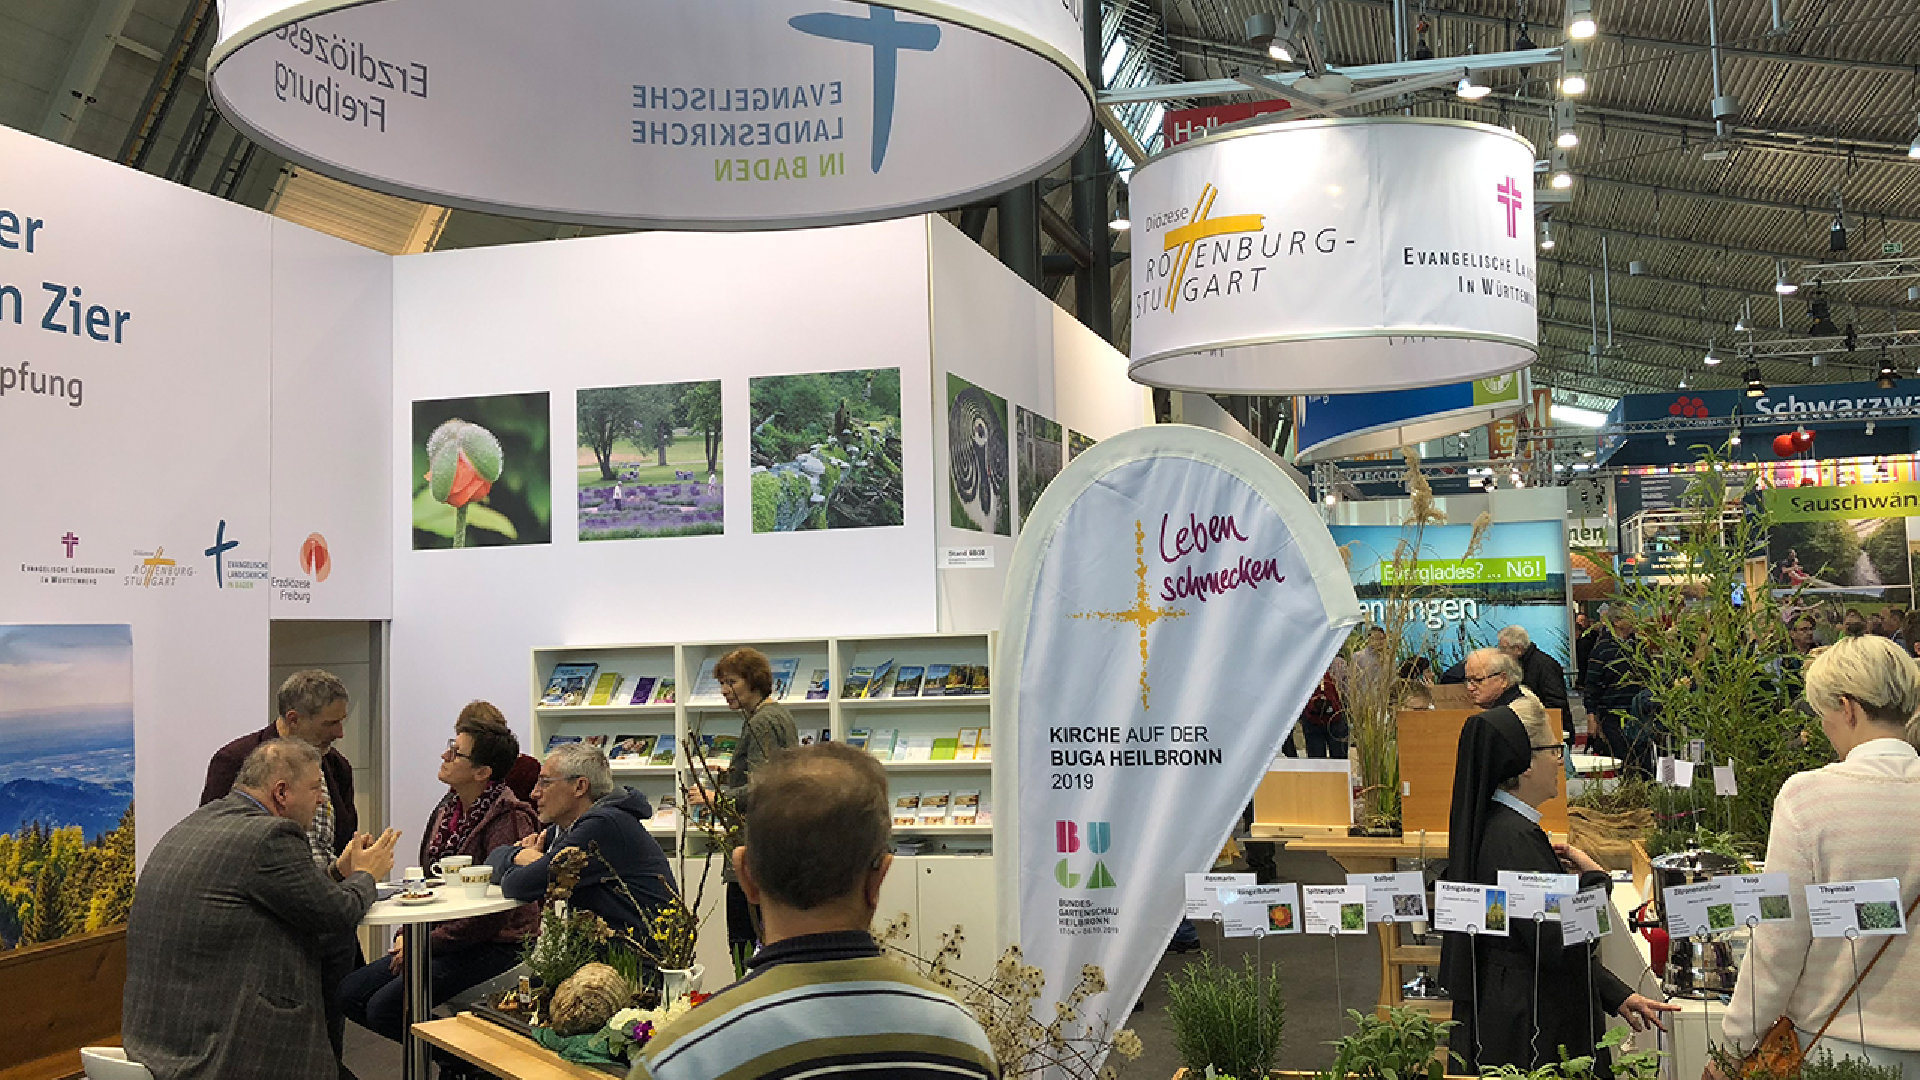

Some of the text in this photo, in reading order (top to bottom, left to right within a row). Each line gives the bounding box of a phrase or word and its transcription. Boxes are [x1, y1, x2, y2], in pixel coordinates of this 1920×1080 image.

[0, 209, 43, 253] er
[1146, 206, 1189, 232] Diözese
[42, 281, 131, 344] Zier
[0, 360, 82, 407] pfung
[1790, 492, 1919, 514] Sauschwän
[1159, 513, 1249, 563] Leben
[1160, 555, 1286, 602] schmecken
[1506, 560, 1541, 578] Nö!
[279, 589, 311, 603] Freiburg
[1050, 726, 1209, 743] KIRCHE AUF DER
[1051, 749, 1222, 766] BUGA HEILBRONN
[1052, 774, 1094, 790] 2019
